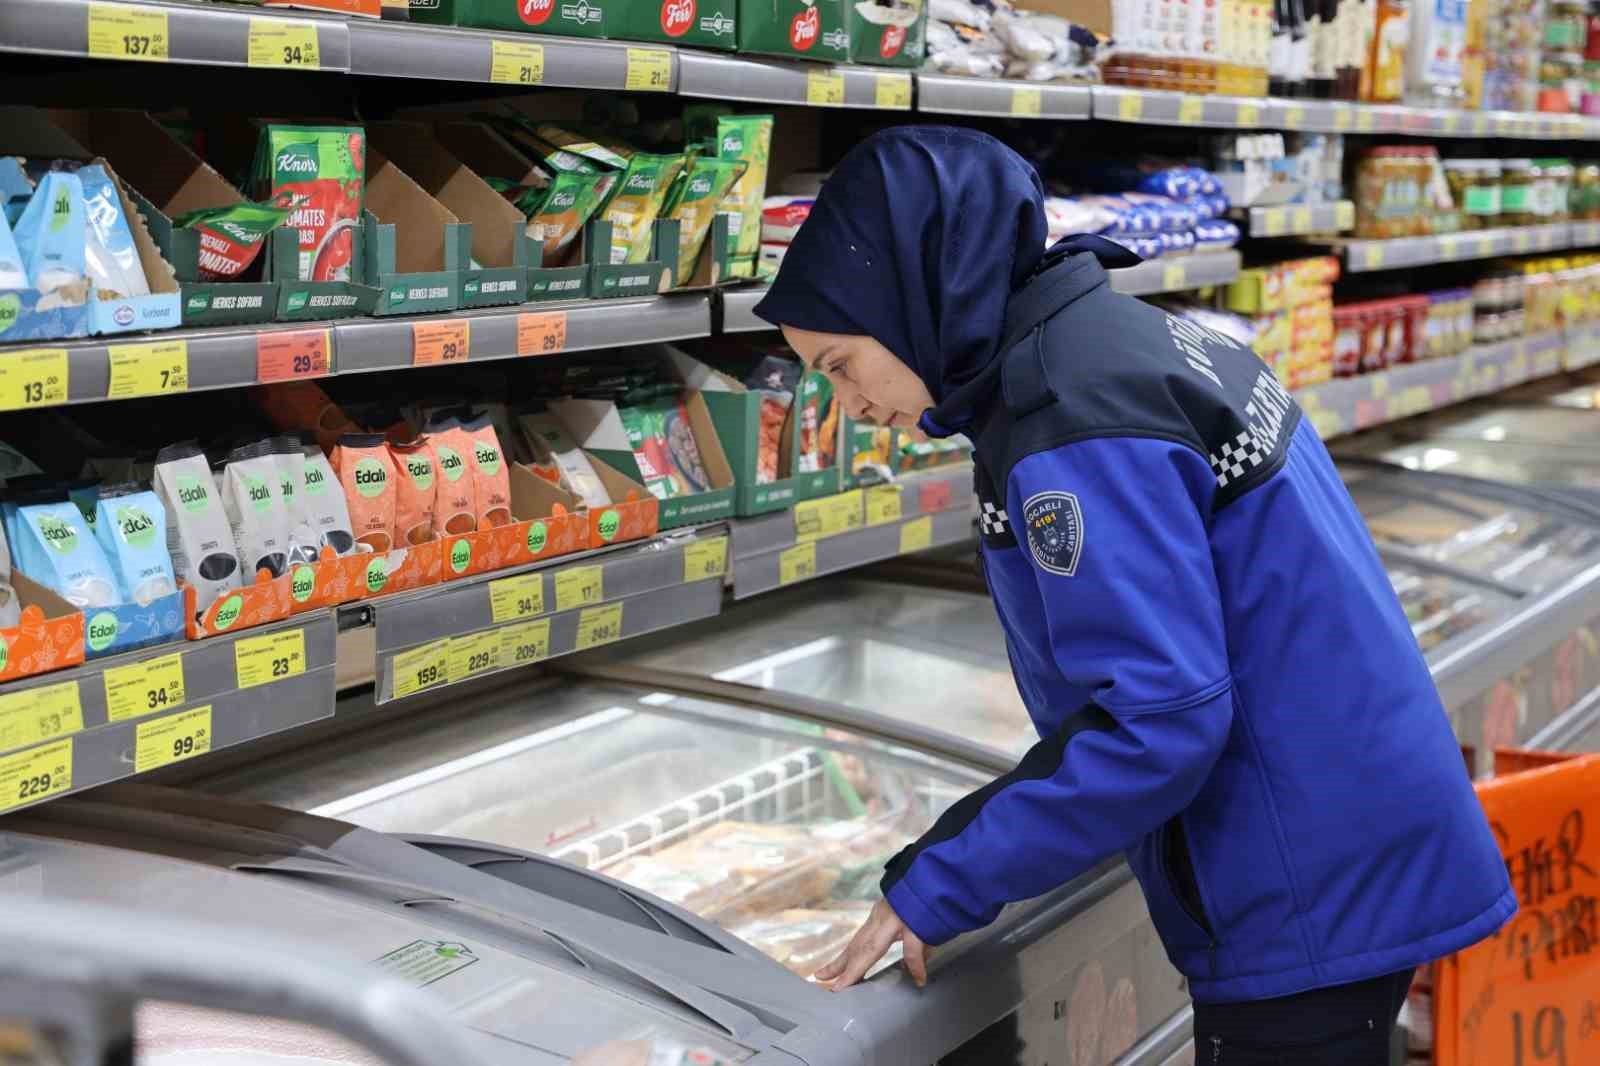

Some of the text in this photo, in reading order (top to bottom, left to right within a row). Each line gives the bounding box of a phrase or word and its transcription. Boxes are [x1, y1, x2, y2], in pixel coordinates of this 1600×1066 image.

[123, 35, 150, 55] 137
[283, 46, 302, 64] 34
[519, 66, 533, 82] 21
[277, 153, 318, 172] Knorr
[199, 247, 241, 275] OMATES
[442, 343, 458, 360] 29
[542, 335, 557, 351] 29
[293, 355, 312, 373] 29
[160, 370, 170, 389] 7
[24, 382, 43, 403] 13
[517, 597, 532, 614] 34
[468, 652, 490, 671] 229
[514, 643, 537, 661] 209
[272, 657, 289, 677] 23
[417, 666, 438, 686] 159
[147, 688, 169, 708] 34
[173, 736, 194, 758] 99
[19, 773, 52, 799] 229
